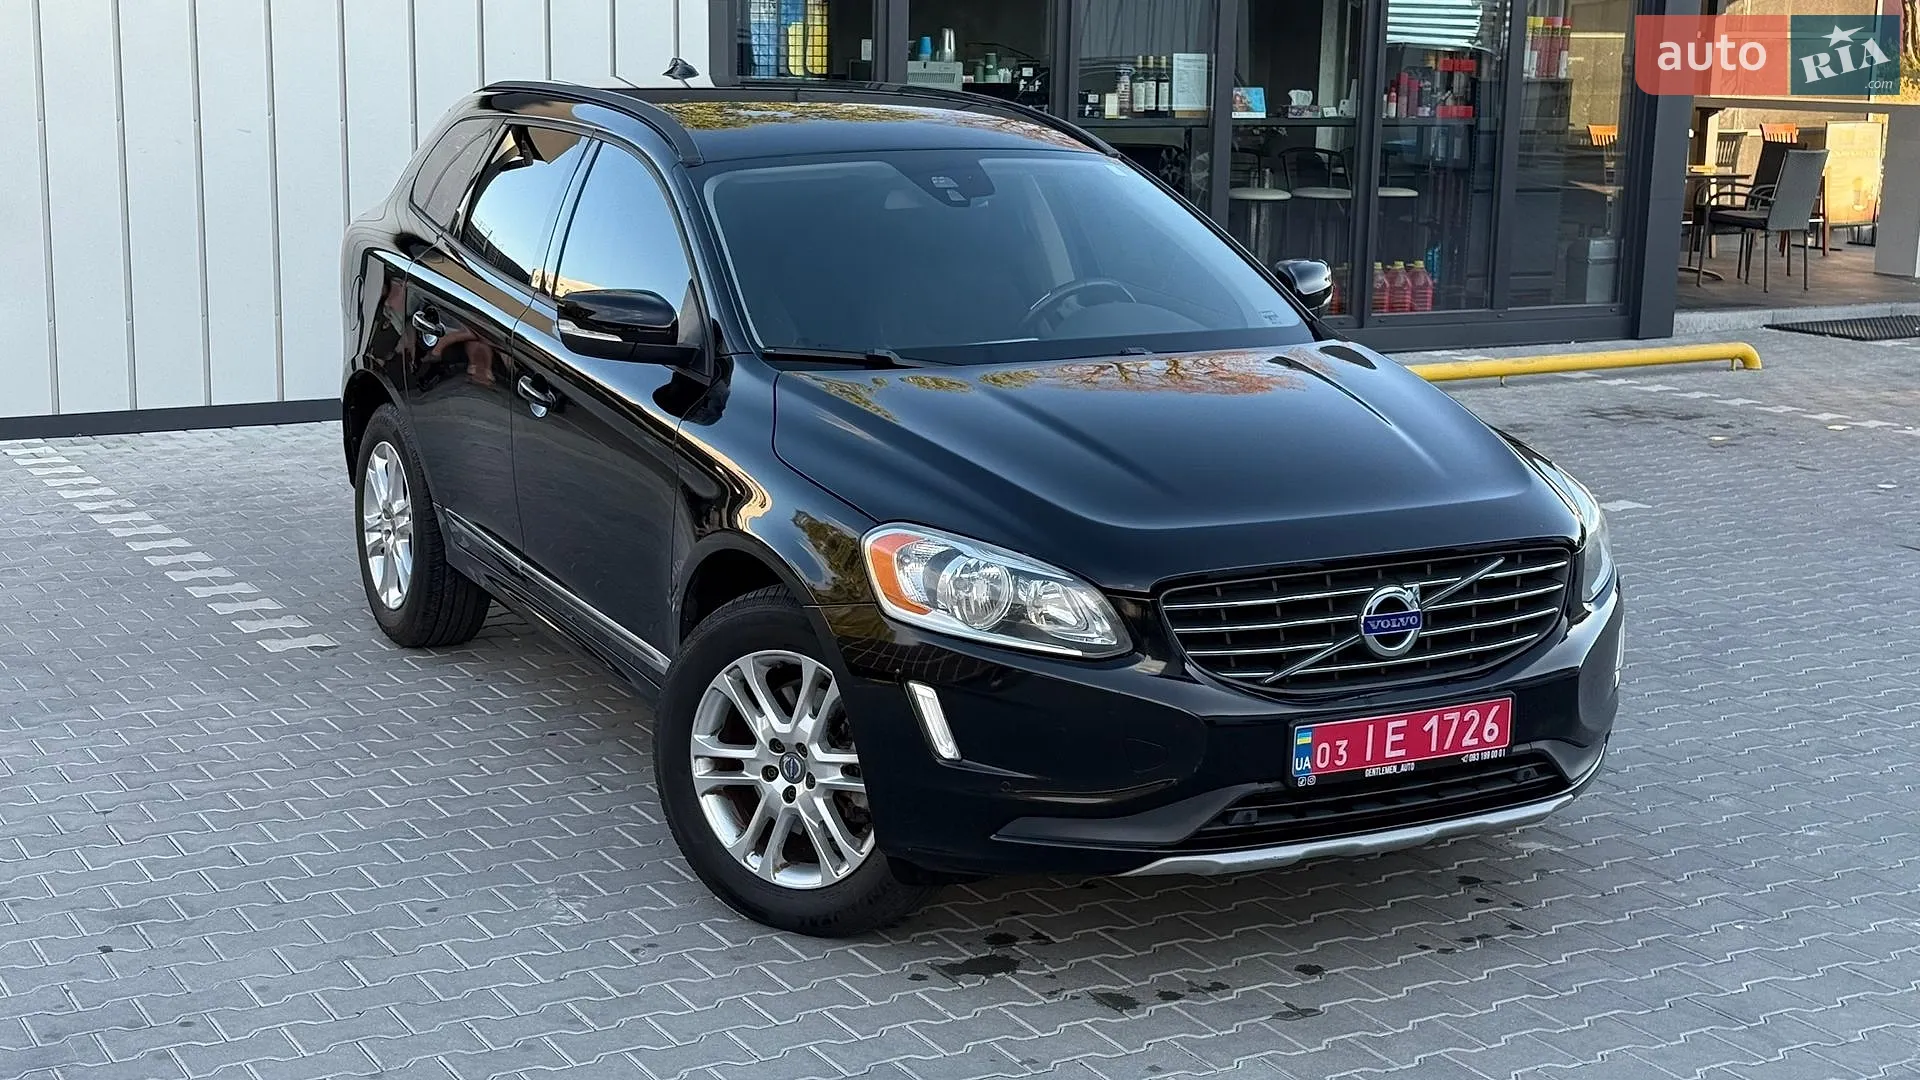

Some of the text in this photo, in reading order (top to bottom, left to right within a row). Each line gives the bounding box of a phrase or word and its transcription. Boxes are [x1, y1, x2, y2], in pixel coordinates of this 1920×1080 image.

[1367, 615, 1418, 630] VOLVO
[1316, 705, 1500, 769] 03 IE 1726
[1295, 756, 1312, 771] UA
